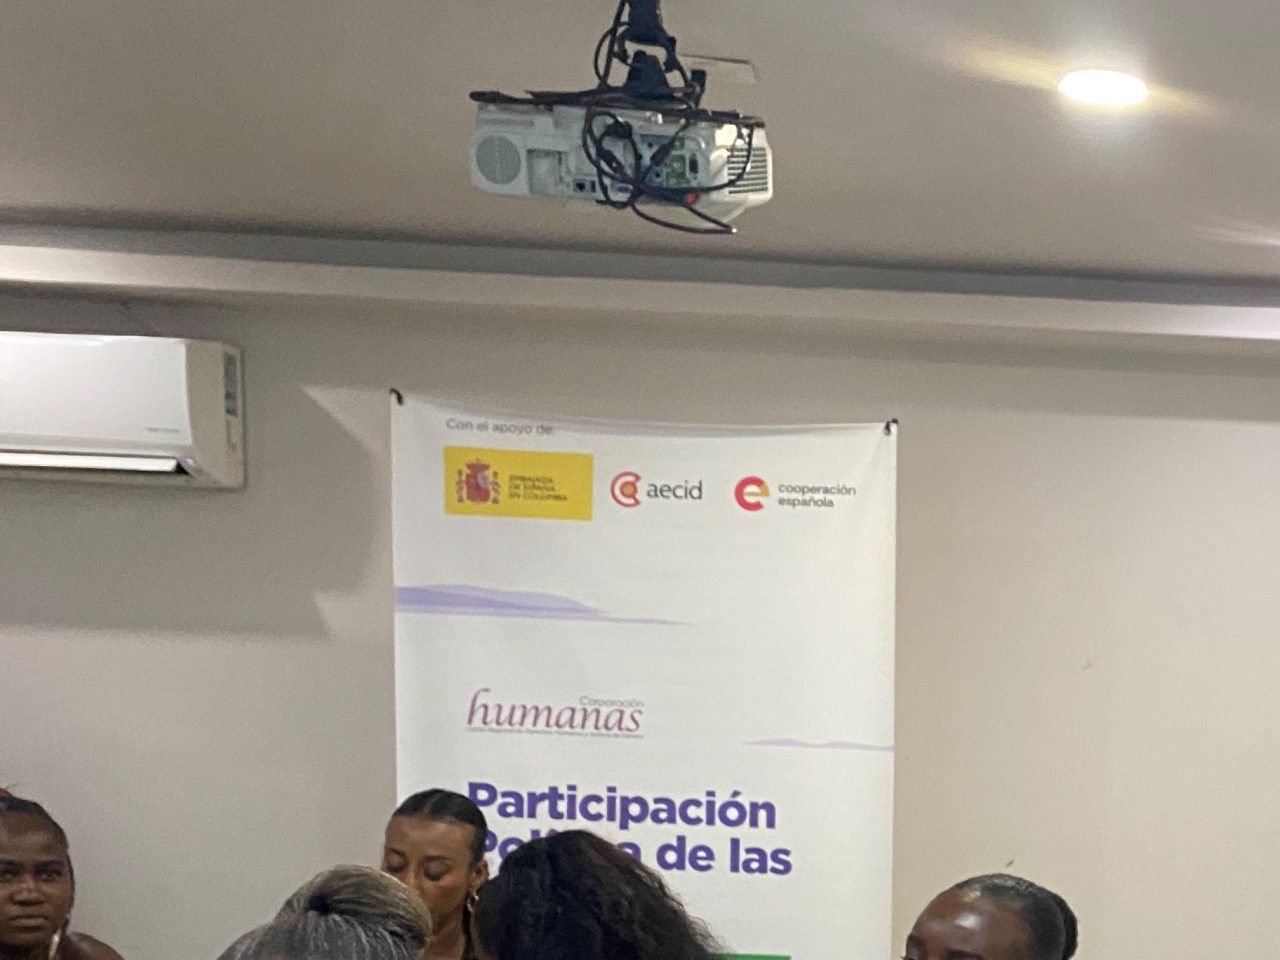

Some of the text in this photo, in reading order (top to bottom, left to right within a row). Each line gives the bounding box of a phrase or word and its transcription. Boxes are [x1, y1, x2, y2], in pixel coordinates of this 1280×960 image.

[446, 418, 474, 431] Con
[477, 420, 489, 432] el
[492, 423, 533, 435] apoyo
[646, 479, 704, 500] aecid
[778, 482, 857, 497] cooperación
[778, 495, 835, 509] española
[467, 687, 643, 733] humanas
[579, 695, 645, 708] Corporación
[468, 781, 776, 830] Participación
[656, 835, 715, 872] de
[730, 837, 793, 876] las
